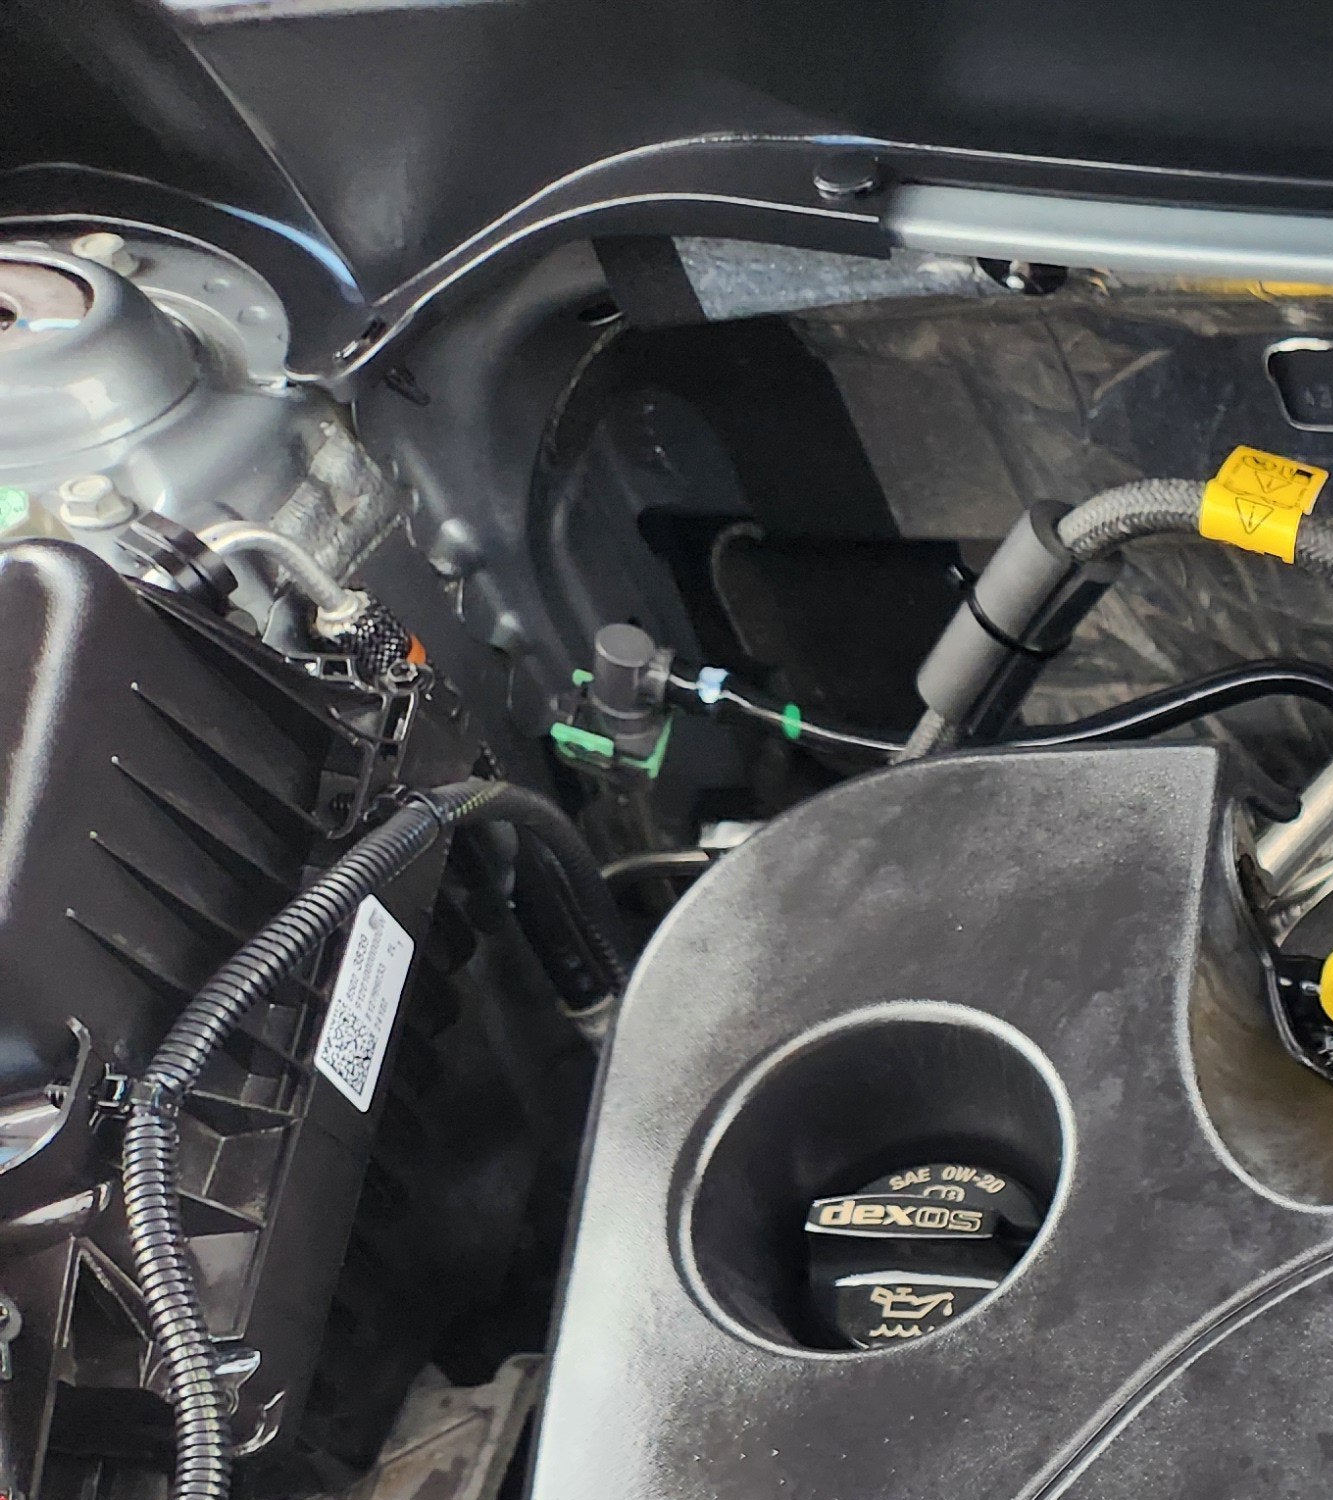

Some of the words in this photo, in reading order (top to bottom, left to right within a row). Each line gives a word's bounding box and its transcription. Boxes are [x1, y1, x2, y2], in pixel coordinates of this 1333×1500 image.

[888, 1167, 931, 1191] SAE
[940, 1166, 1006, 1194] 0W-20
[819, 1199, 984, 1233] dexos
